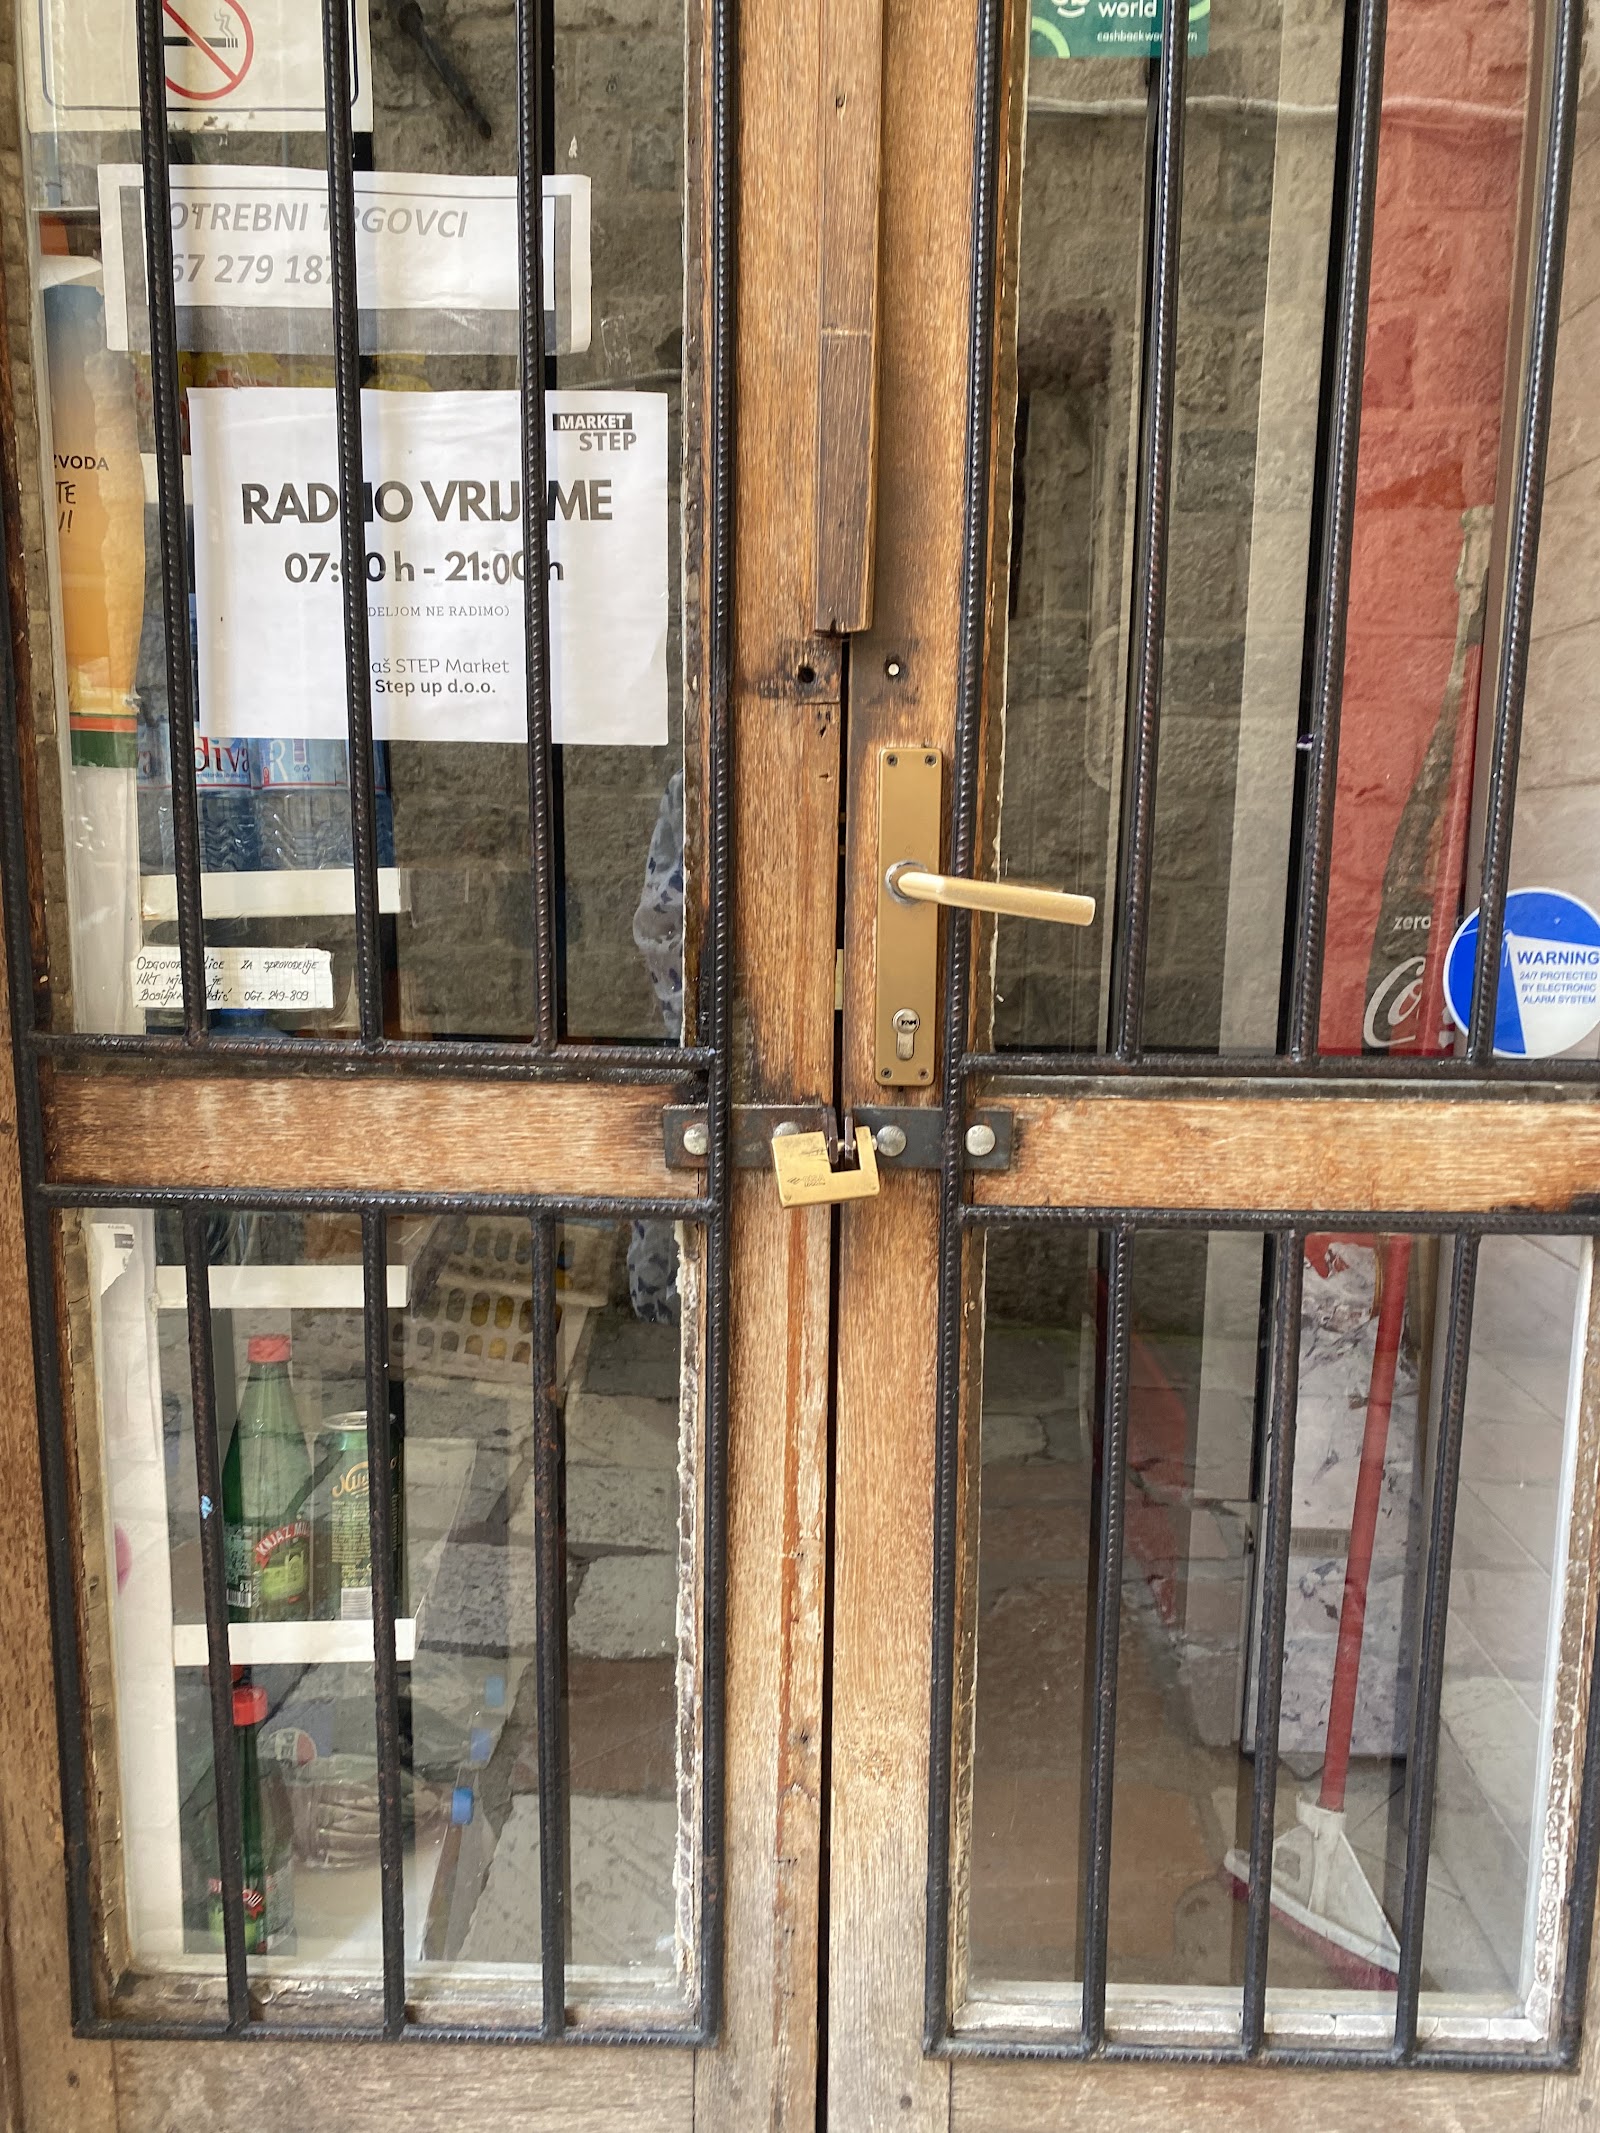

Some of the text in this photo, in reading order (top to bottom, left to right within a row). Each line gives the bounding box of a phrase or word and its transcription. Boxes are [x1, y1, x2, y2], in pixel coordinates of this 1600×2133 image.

[1098, 0, 1157, 18] world
[170, 202, 468, 238] OTREBNI TGOVCI
[172, 253, 206, 283] 67
[214, 254, 274, 284] 279
[560, 414, 626, 430] MARKET
[579, 431, 637, 452] STEP
[54, 453, 109, 471] VODA
[241, 479, 613, 524] RADO VRIJME
[284, 552, 387, 583] 07:0
[394, 550, 415, 582] h
[426, 606, 444, 617] NE
[449, 605, 510, 617] RADIMO)
[371, 658, 510, 674] aš STEP Market
[375, 679, 496, 697] Step up d.o.o.
[1393, 915, 1432, 931] zero
[1517, 951, 1600, 965] WARNING
[1540, 971, 1598, 981] PROTECTED
[1522, 983, 1597, 993] BY ELECTRONIC
[1523, 995, 1596, 1004] ALARM SYSTEM
